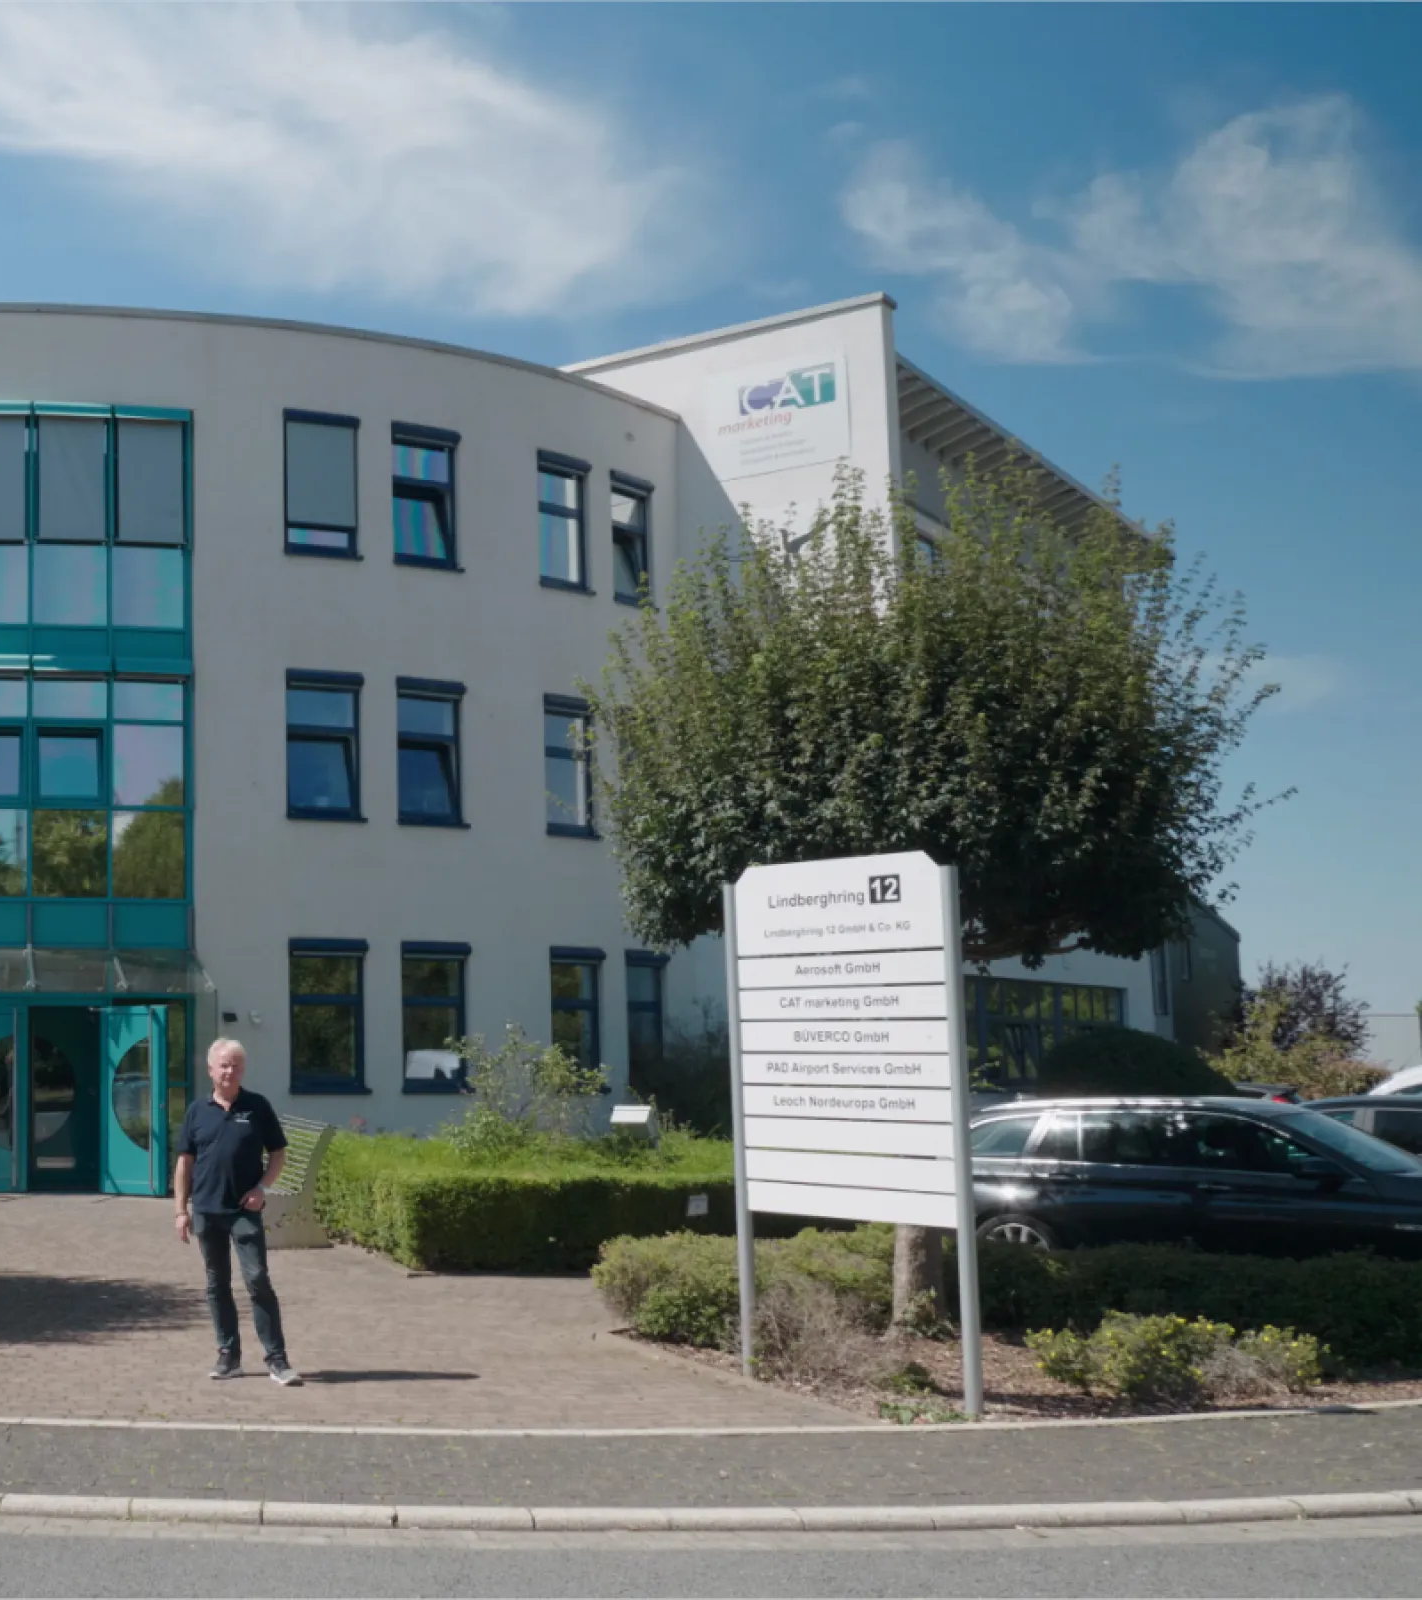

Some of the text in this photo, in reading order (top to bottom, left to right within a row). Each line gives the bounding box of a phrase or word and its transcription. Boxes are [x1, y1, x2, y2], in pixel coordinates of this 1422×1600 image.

[741, 366, 832, 413] CAT
[718, 411, 793, 436] marketing
[768, 876, 899, 909] Lindberghring 12
[764, 926, 823, 938] Lindberghring
[826, 925, 836, 934] 12
[838, 923, 866, 934] GmbH
[869, 923, 875, 932] &
[896, 920, 911, 931] KG
[794, 962, 881, 975] Aerosoft GmbH
[779, 995, 899, 1010] CAT marketing GmbH
[793, 1029, 890, 1043] BÜVERCO GmbH
[791, 1062, 829, 1075] Airport
[831, 1063, 881, 1075] Services
[883, 1063, 922, 1075] GmbH
[772, 1095, 916, 1111] Leoch Nordeuropa GmbH
